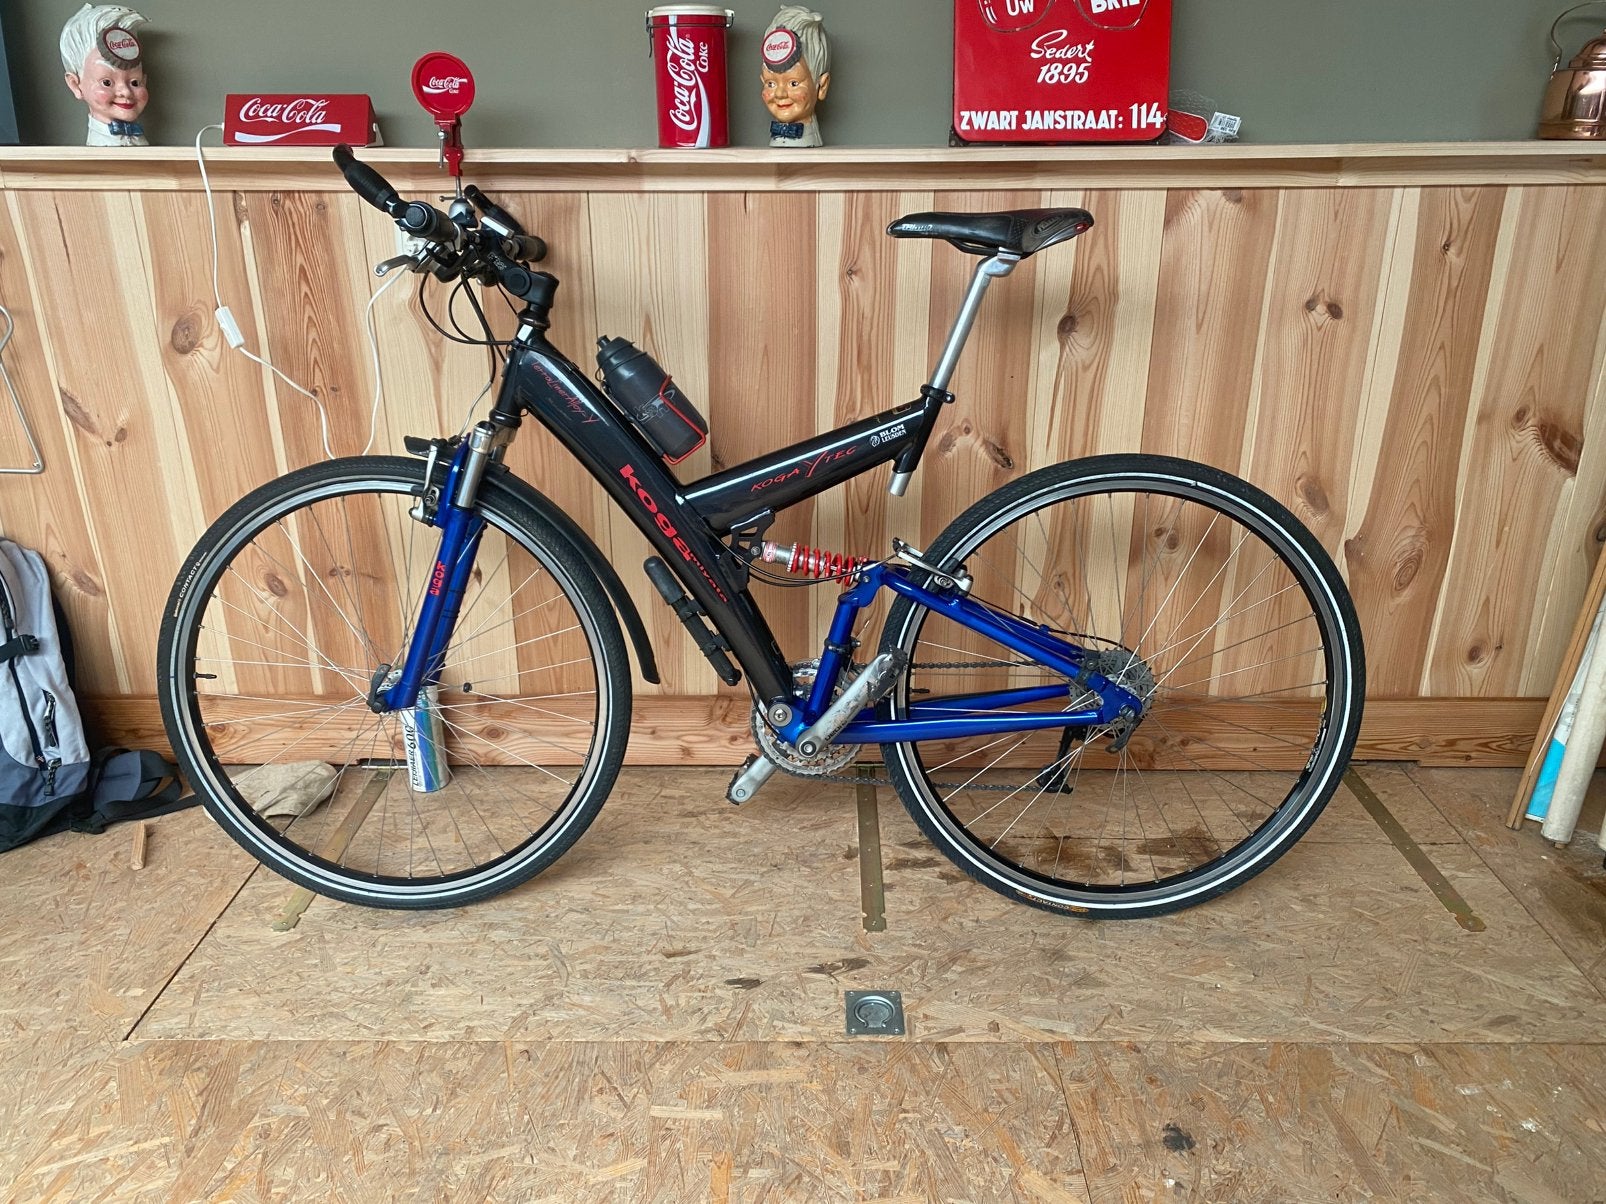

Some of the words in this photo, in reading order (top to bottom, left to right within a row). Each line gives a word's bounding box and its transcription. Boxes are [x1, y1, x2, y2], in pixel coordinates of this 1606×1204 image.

[696, 41, 709, 73] Coke
[1030, 29, 1095, 62] Sedert
[666, 33, 698, 131] Coca-Cola
[1036, 62, 1092, 84] 1895
[239, 97, 330, 123] Coca-Cola
[960, 110, 1019, 131] ZWART
[1021, 109, 1124, 131] JANSTRAAT:
[879, 424, 905, 438] BLOM
[751, 468, 800, 492] KOGA
[178, 565, 198, 598] CONTACT
